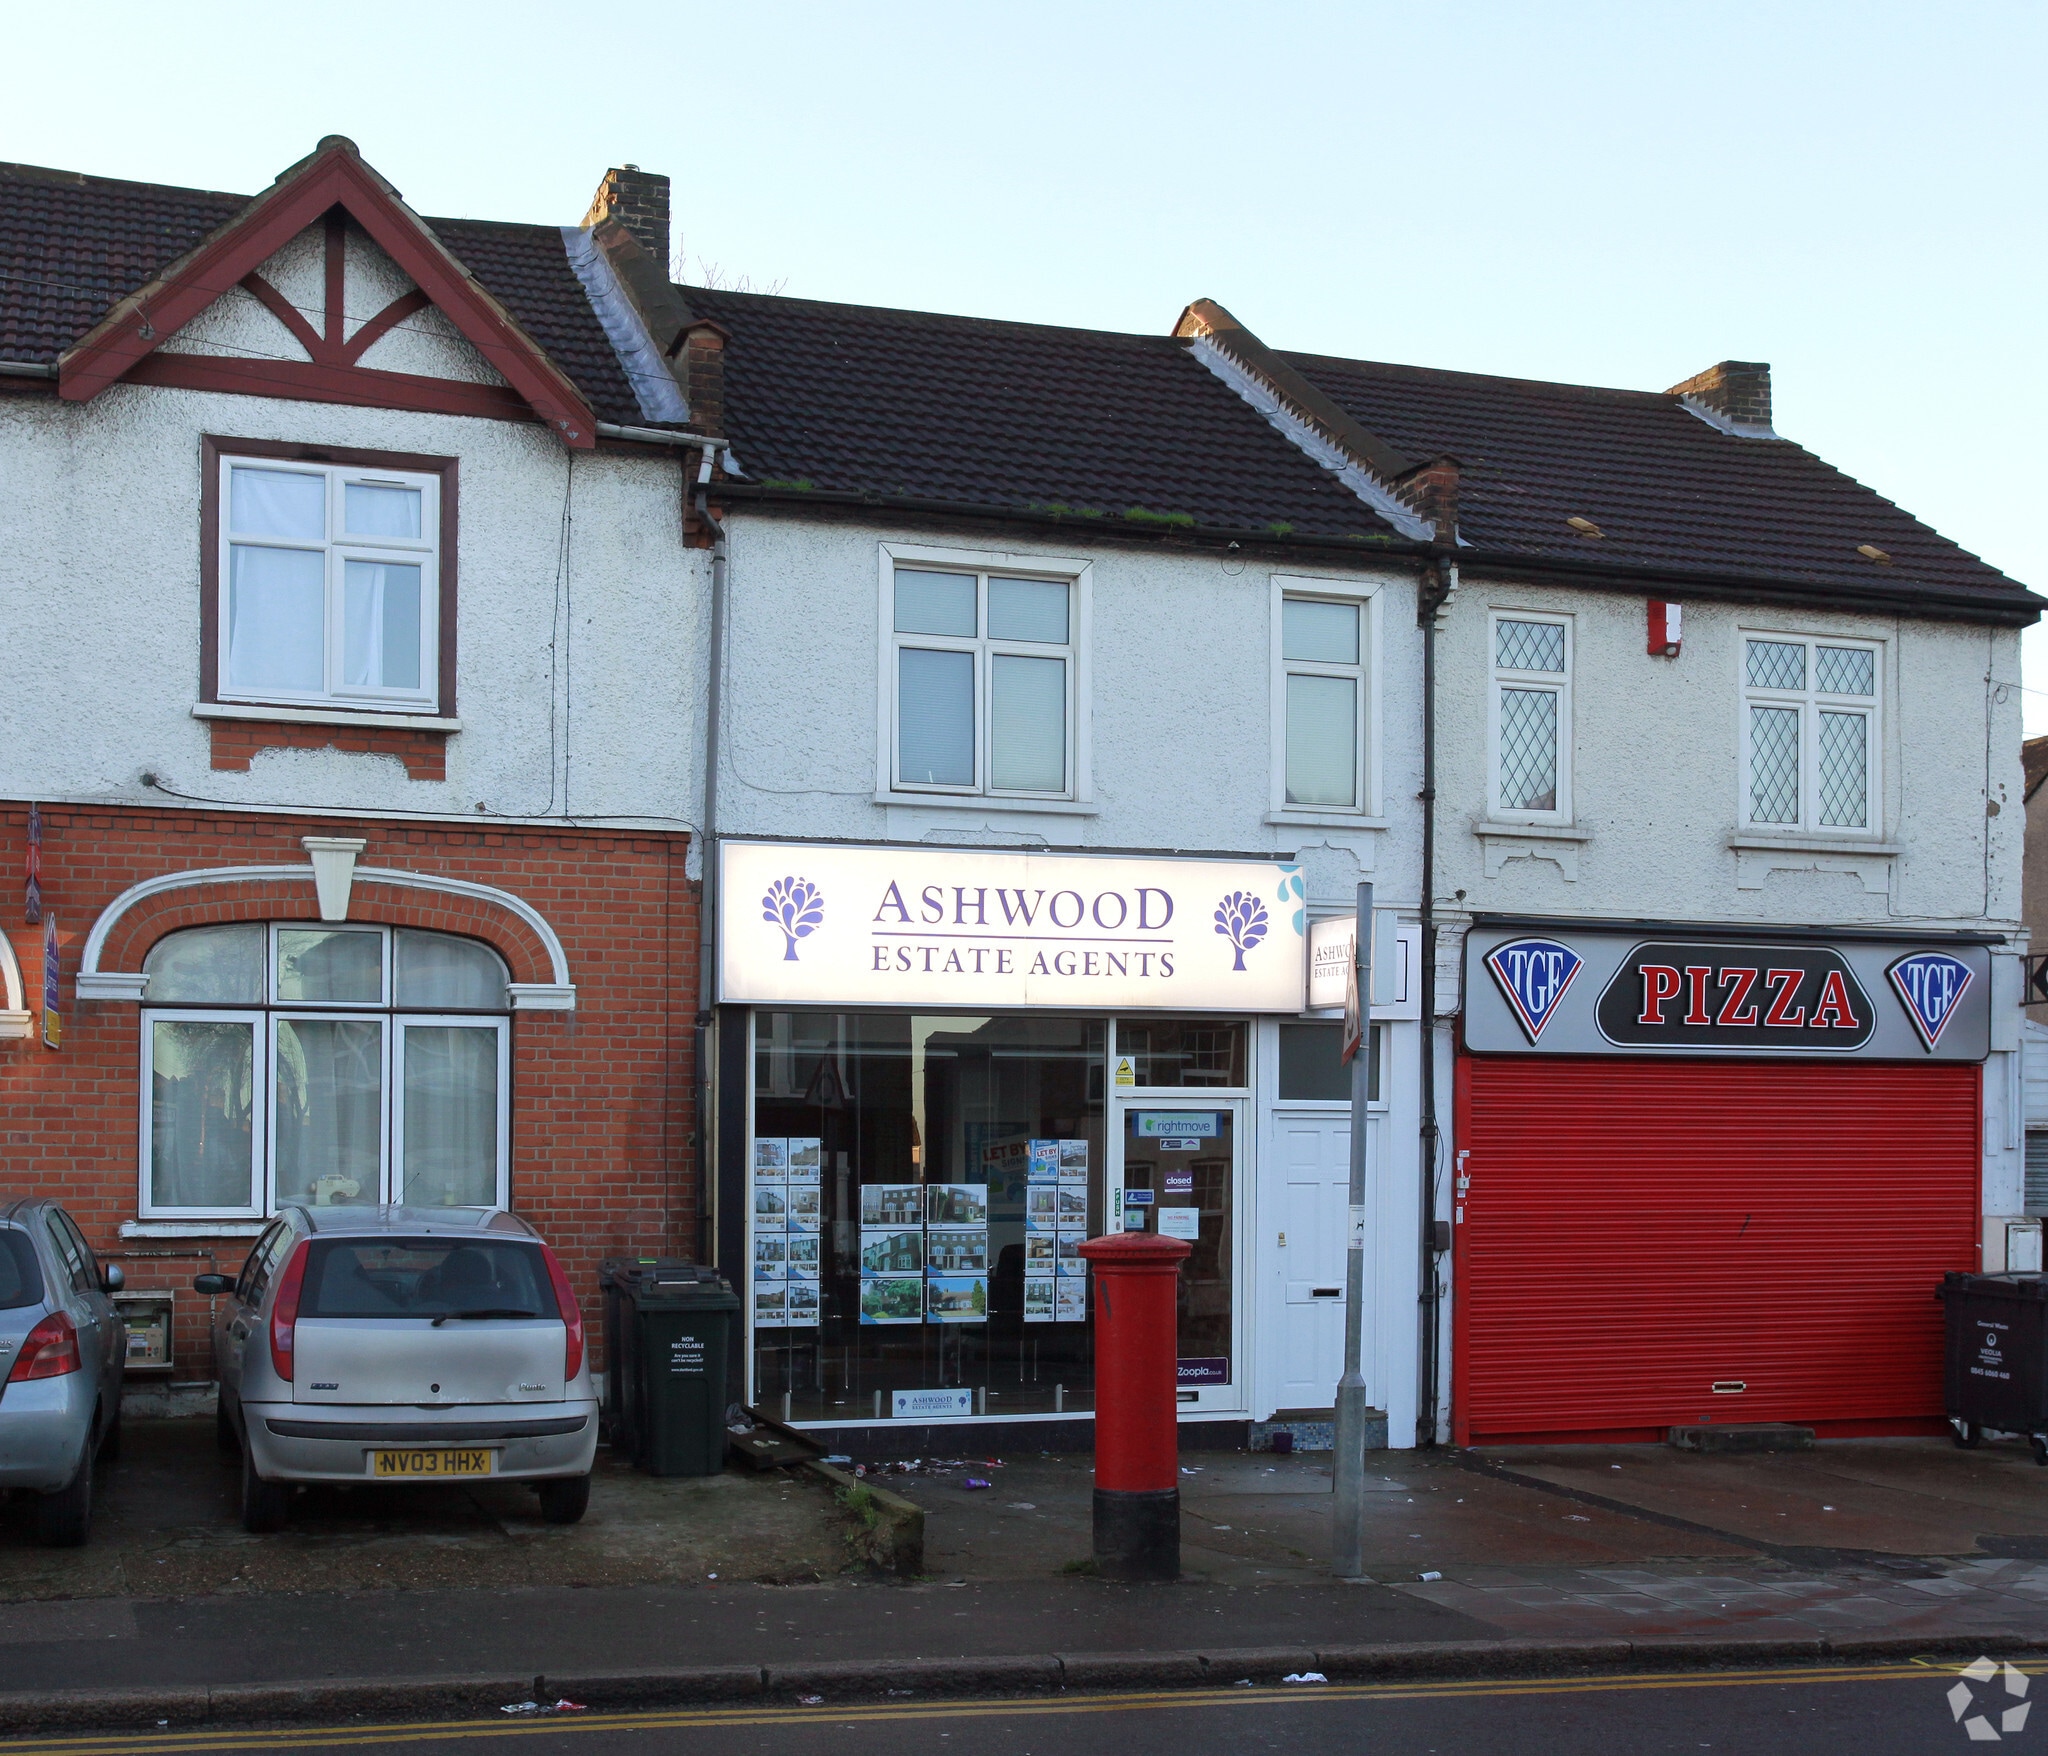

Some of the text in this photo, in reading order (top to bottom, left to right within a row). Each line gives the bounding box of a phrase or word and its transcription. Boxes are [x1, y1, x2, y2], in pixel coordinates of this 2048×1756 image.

[872, 879, 1174, 929] ASHWOOD
[1315, 943, 1356, 961] ASHWO
[871, 946, 1174, 978] ESTATE AGENTS
[1314, 966, 1339, 978] ESTATE
[1508, 950, 1563, 1013] TGF
[1638, 964, 1859, 1028] PIZZA
[1907, 964, 1956, 1023] TGF
[1157, 1120, 1211, 1134] rightmove
[1166, 1176, 1192, 1185] closed
[1980, 1348, 2001, 1356] VEOLIA
[519, 1383, 546, 1391] Punto
[383, 1453, 483, 1472] NV03 HHX
